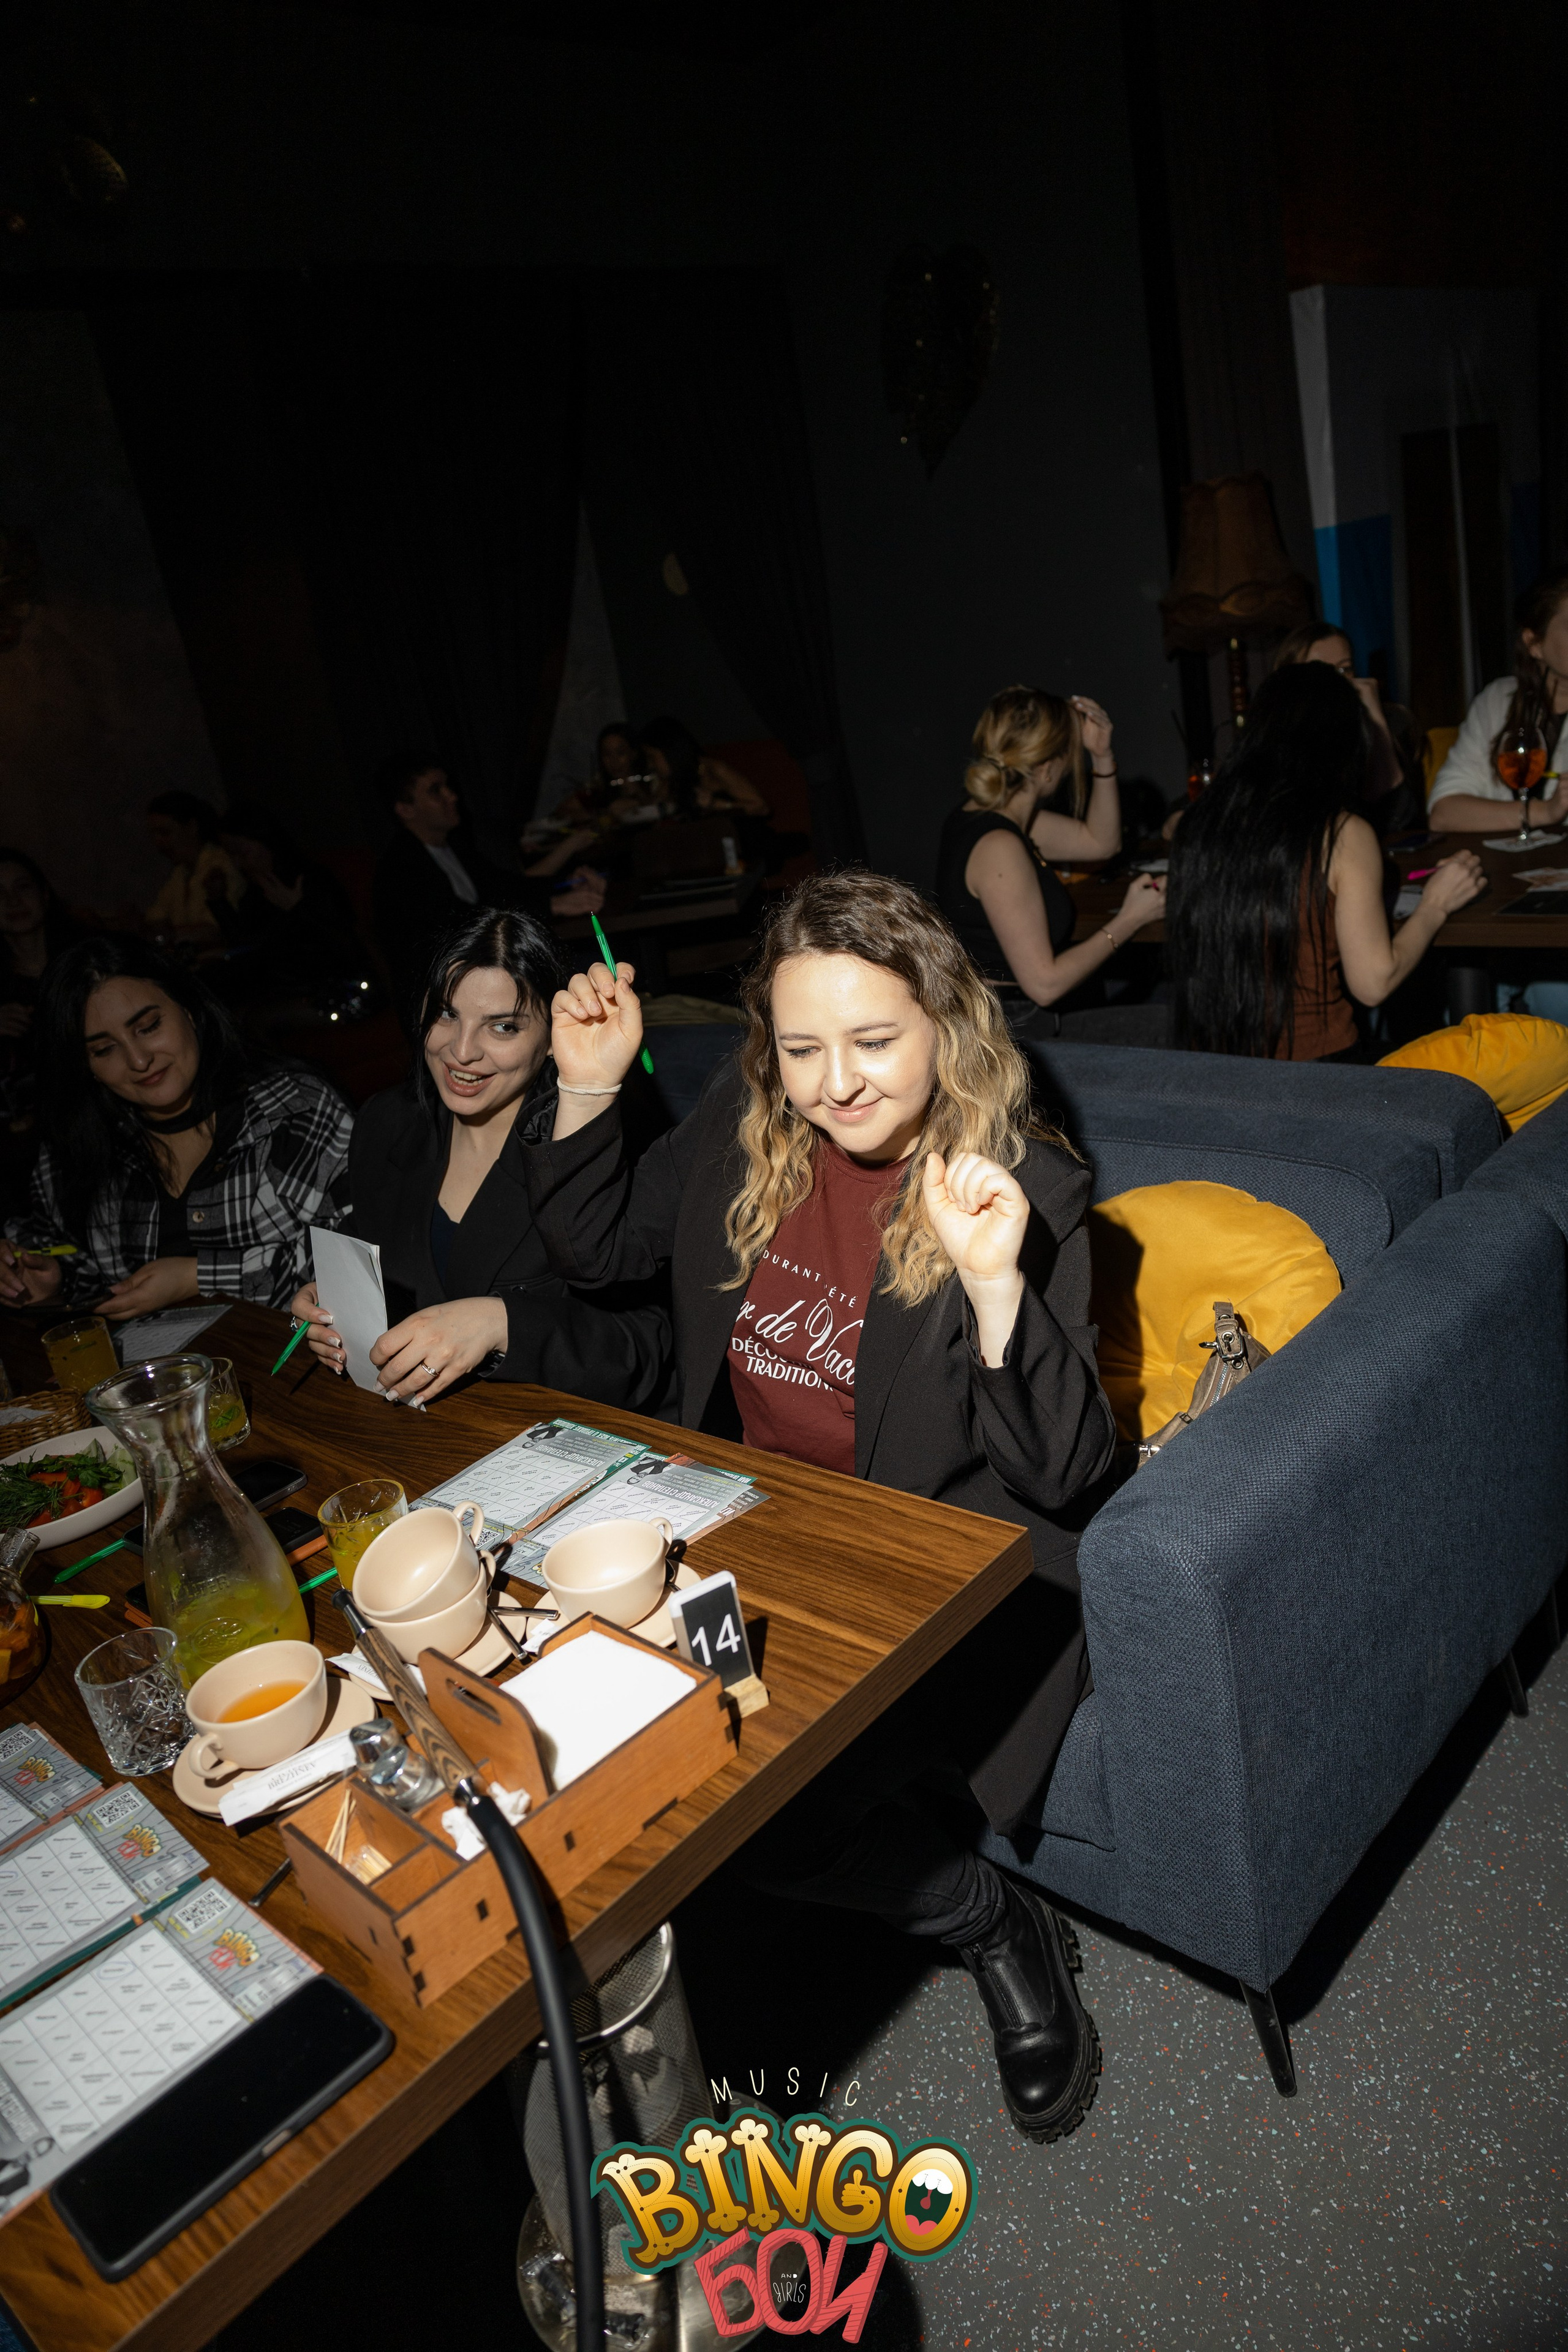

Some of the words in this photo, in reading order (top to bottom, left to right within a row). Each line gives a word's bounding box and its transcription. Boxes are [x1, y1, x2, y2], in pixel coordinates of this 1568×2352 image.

[763, 1249, 821, 1282] DURANT
[755, 1300, 806, 1343] de
[533, 1444, 570, 1457] СТЕПАНОВ
[563, 1452, 606, 1467] АЛЕКСАНДР
[640, 1480, 680, 1496] СТЕПАНОВ
[674, 1490, 720, 1508] АЛЕКСАНДР
[691, 1613, 742, 1667] 14
[23, 1755, 56, 1782] BINGO
[122, 1823, 162, 1859] BINGO
[213, 1927, 262, 1968] BINGO
